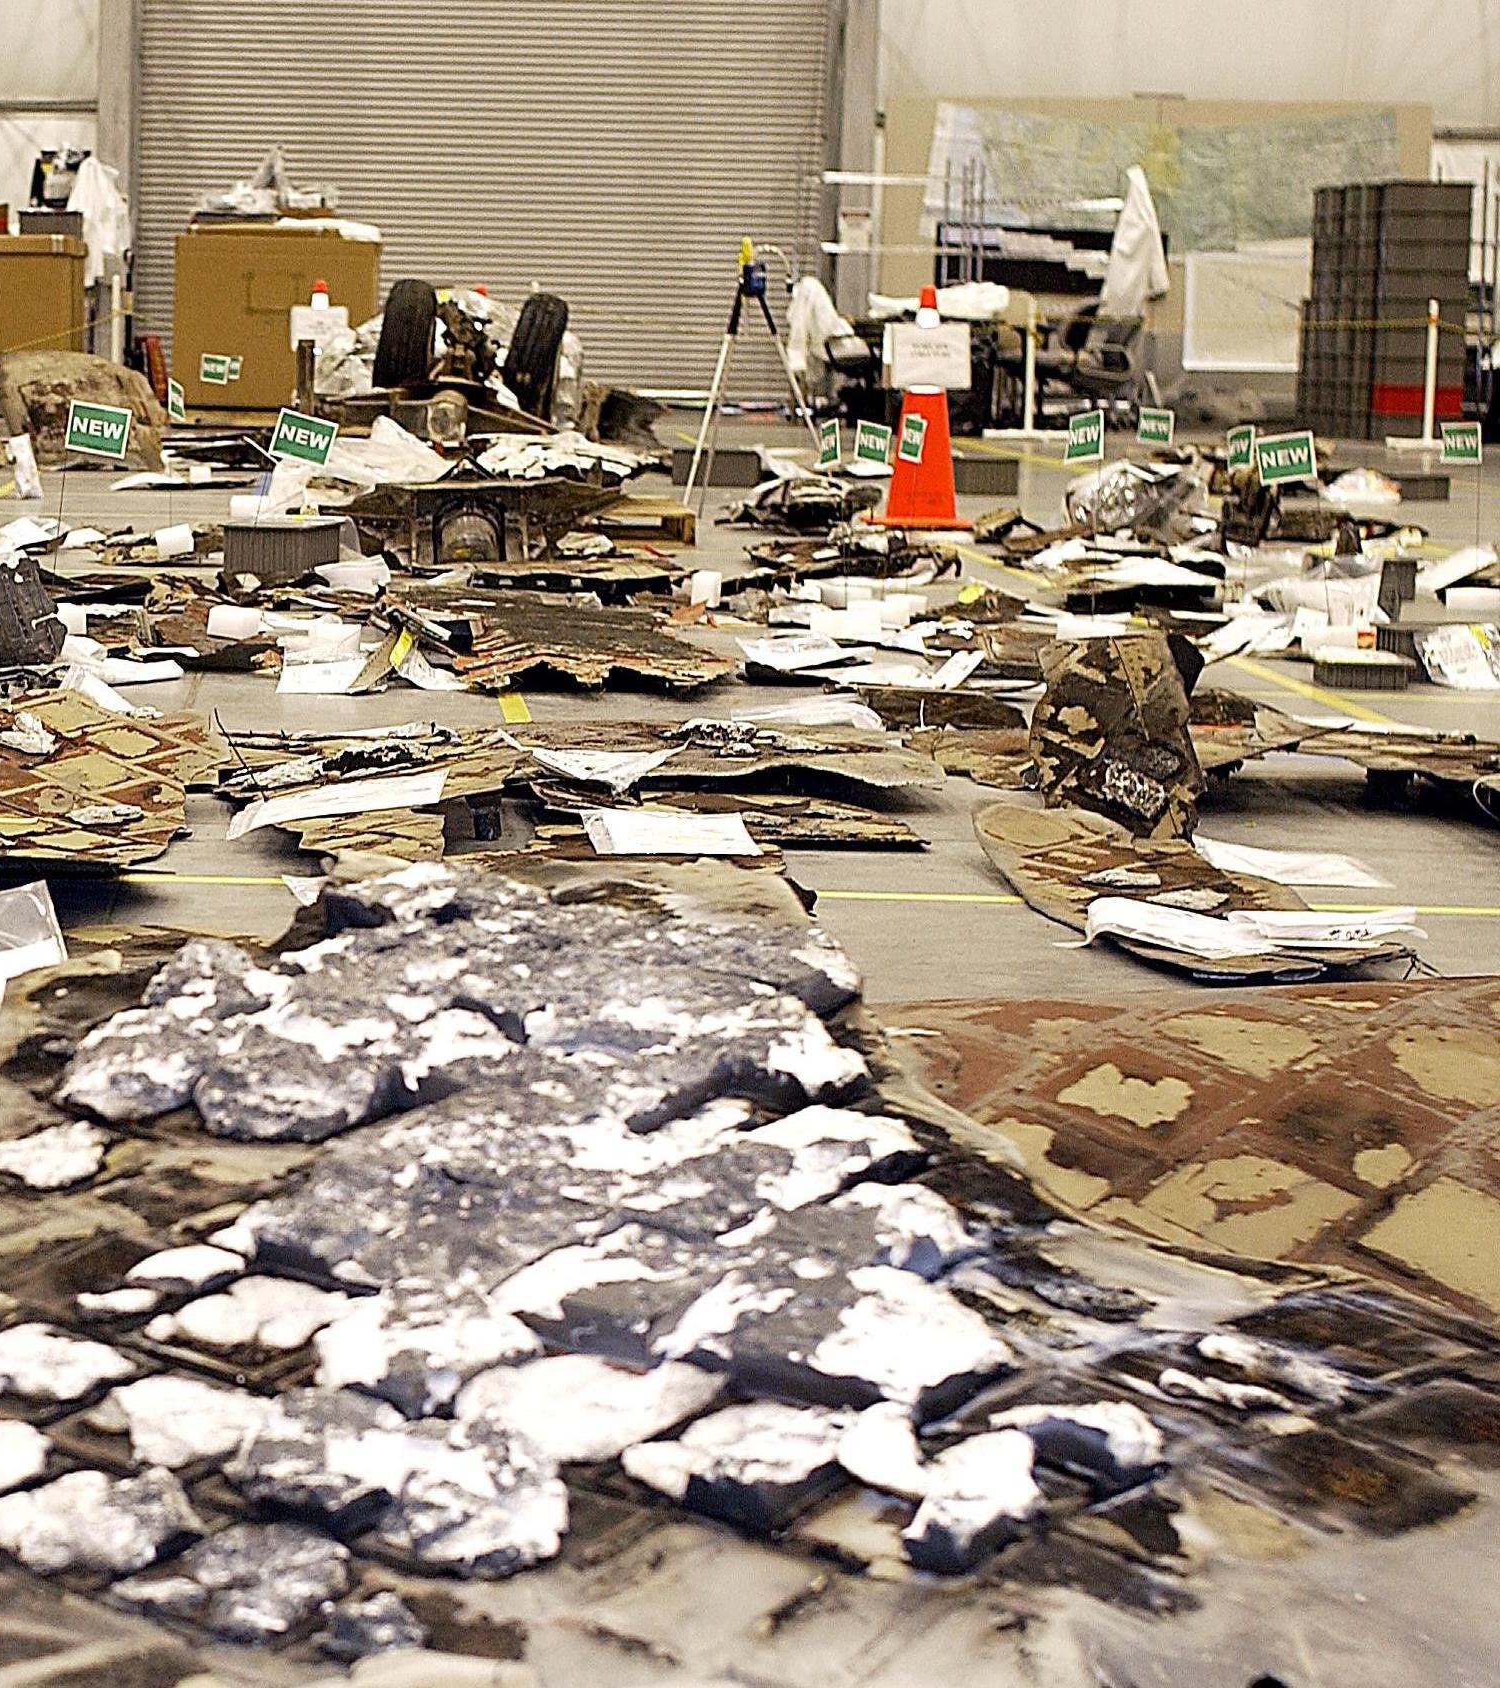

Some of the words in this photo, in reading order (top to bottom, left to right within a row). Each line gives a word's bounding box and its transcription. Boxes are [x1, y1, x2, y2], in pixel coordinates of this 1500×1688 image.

[72, 416, 124, 440] NEW
[279, 423, 330, 450] NEW
[1068, 425, 1099, 446] NEW
[1444, 435, 1477, 450] NEW
[1261, 446, 1309, 469] NEW
